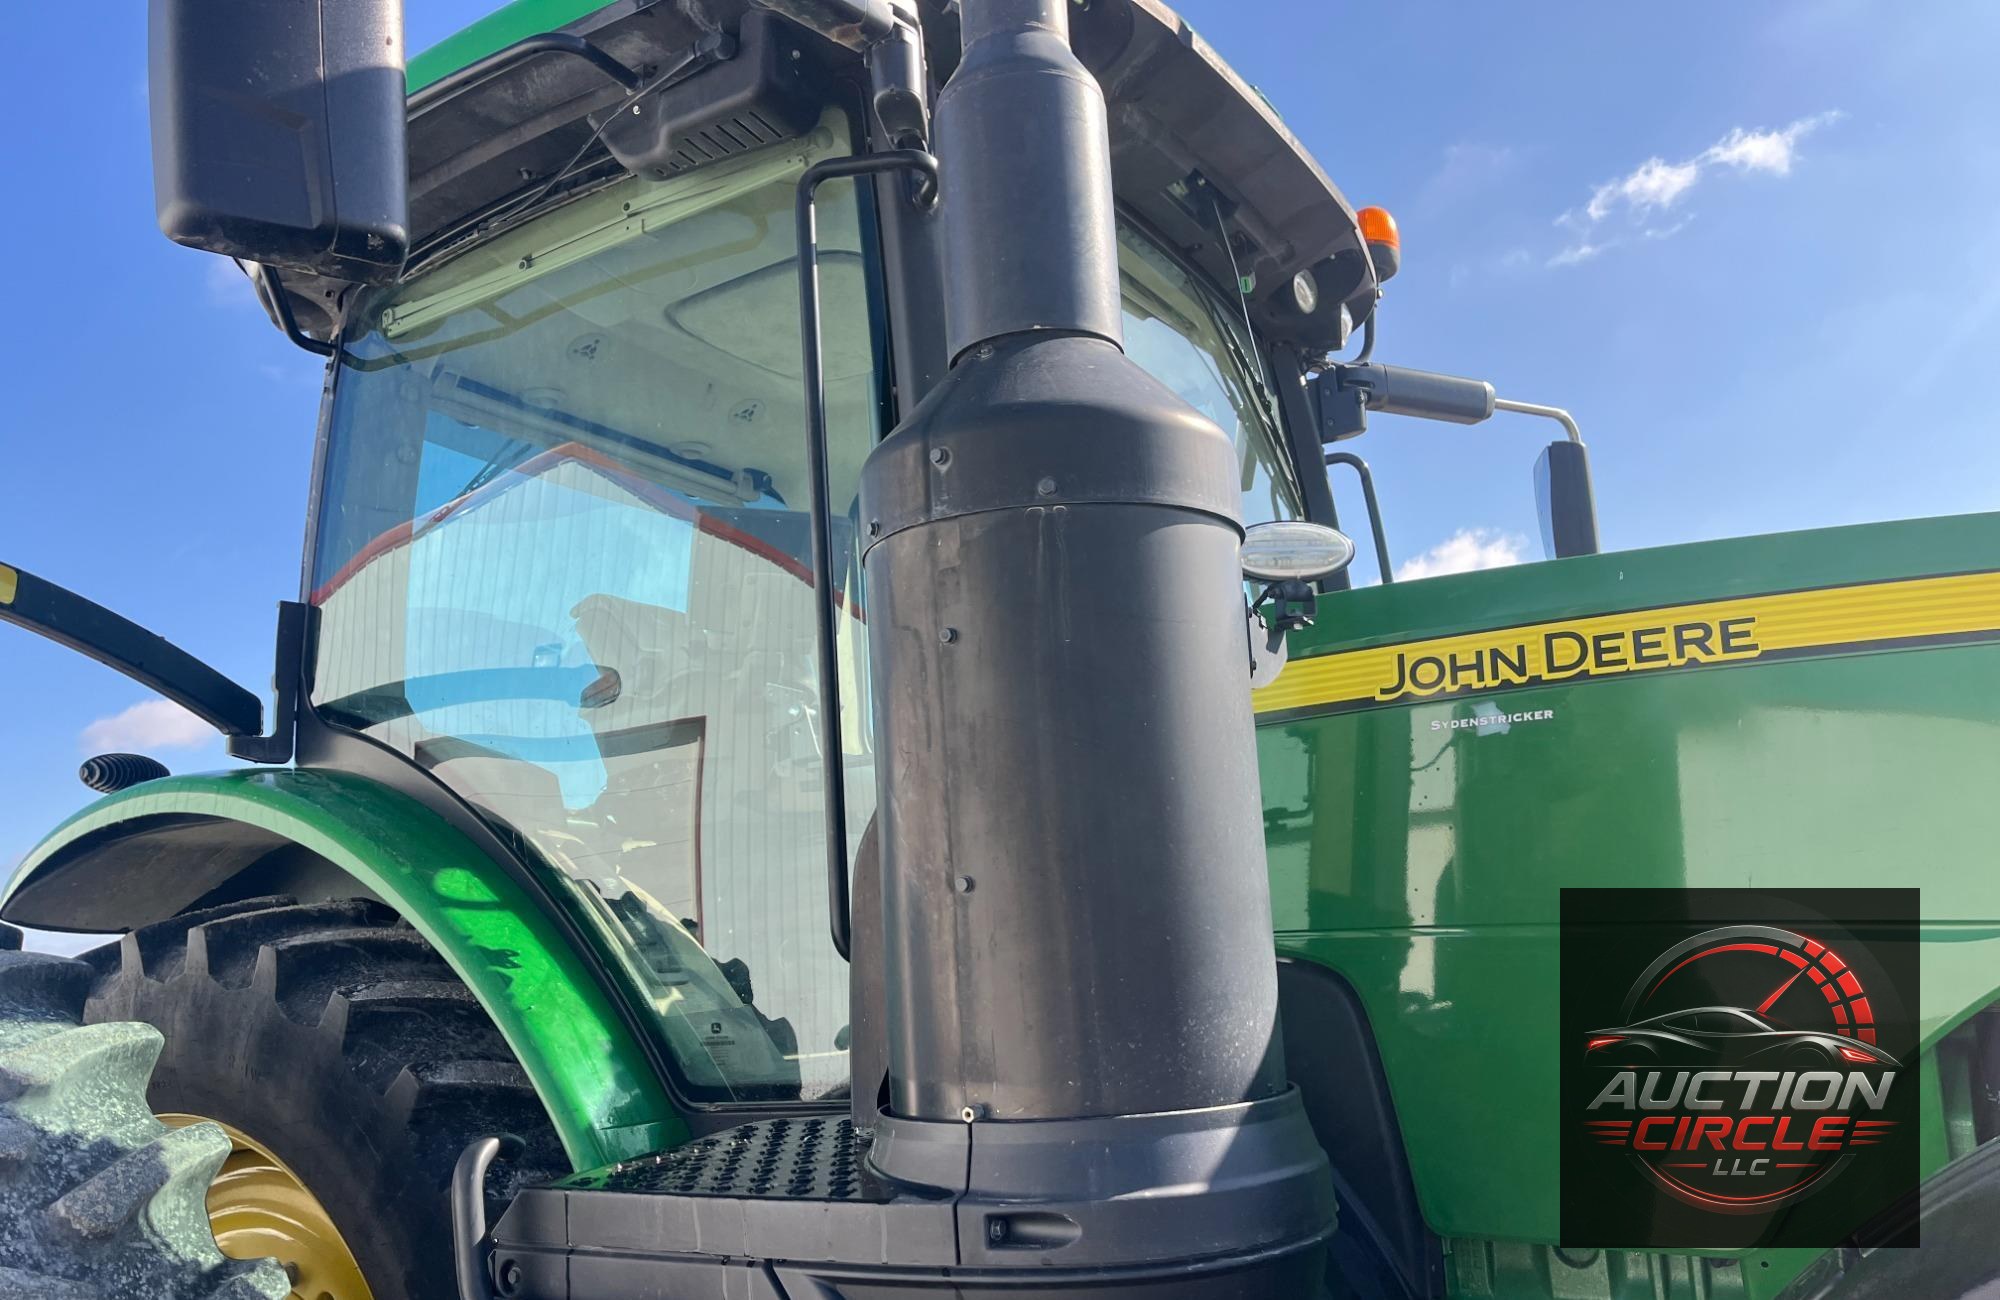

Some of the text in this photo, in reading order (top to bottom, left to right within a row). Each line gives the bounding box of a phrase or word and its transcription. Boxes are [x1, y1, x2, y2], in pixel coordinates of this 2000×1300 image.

[1379, 617, 1760, 696] JOHN DEERE
[1431, 709, 1554, 730] SYDENSTRICKER
